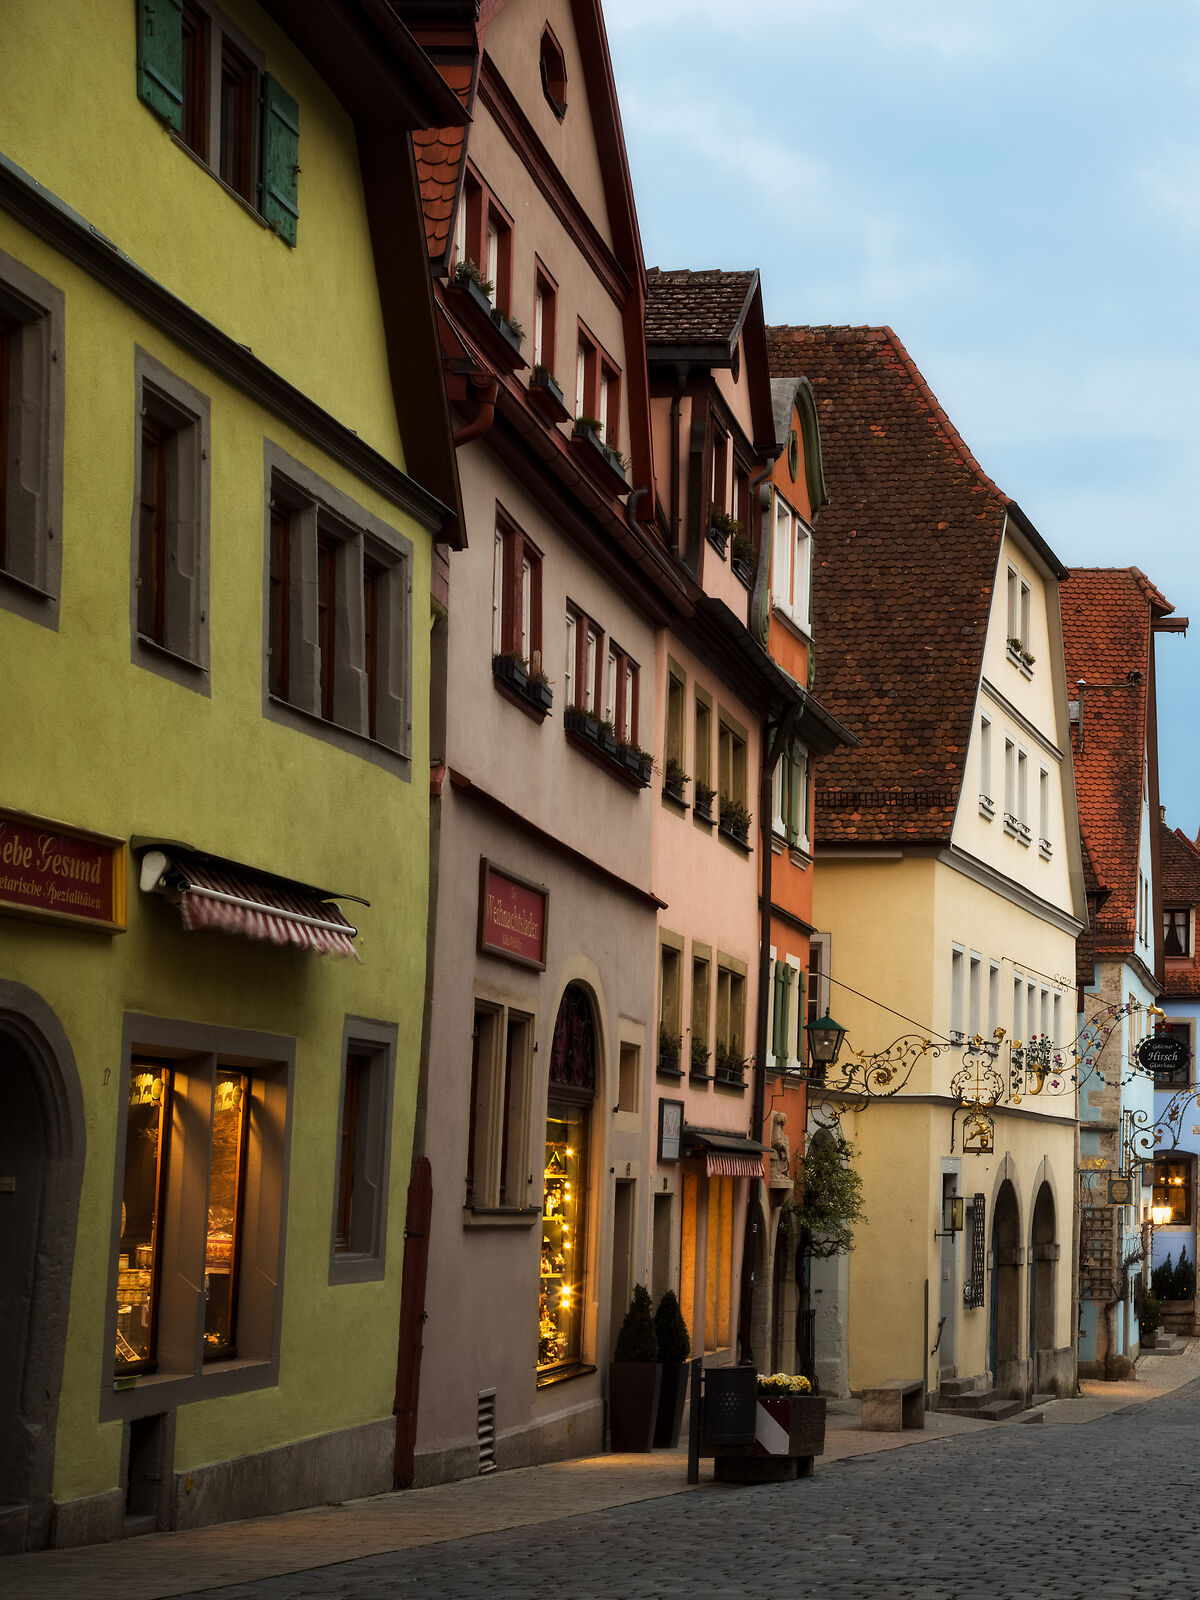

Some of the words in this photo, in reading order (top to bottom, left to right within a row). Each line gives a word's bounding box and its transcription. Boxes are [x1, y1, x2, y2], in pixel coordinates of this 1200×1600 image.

[37, 834, 102, 885] Gesund
[43, 880, 101, 910] Spezialitäten
[1147, 1050, 1179, 1061] Hirsch
